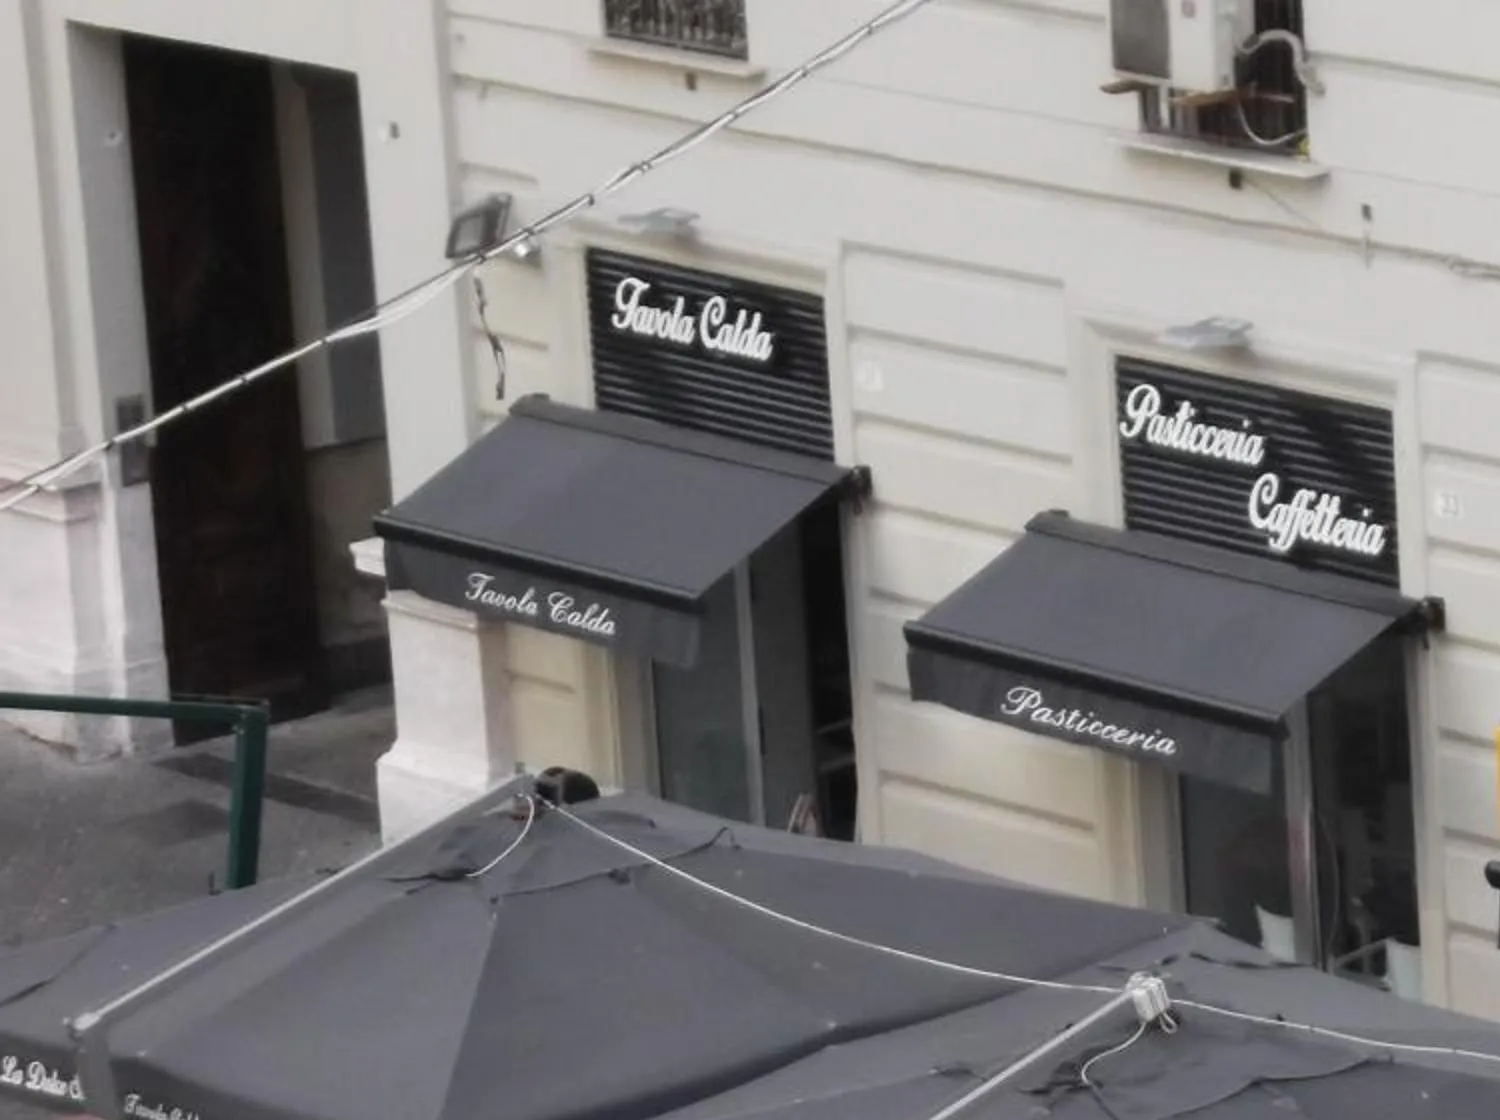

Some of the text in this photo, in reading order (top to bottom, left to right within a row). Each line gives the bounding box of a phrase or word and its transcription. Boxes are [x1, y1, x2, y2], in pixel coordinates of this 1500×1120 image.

[612, 276, 774, 361] Tavola Calda
[1120, 384, 1266, 467] Pasticceria
[1249, 472, 1387, 555] Caffetteria
[465, 572, 617, 636] Tavola Calda
[1001, 685, 1180, 756] Pasticceria
[0, 1055, 23, 1085] La
